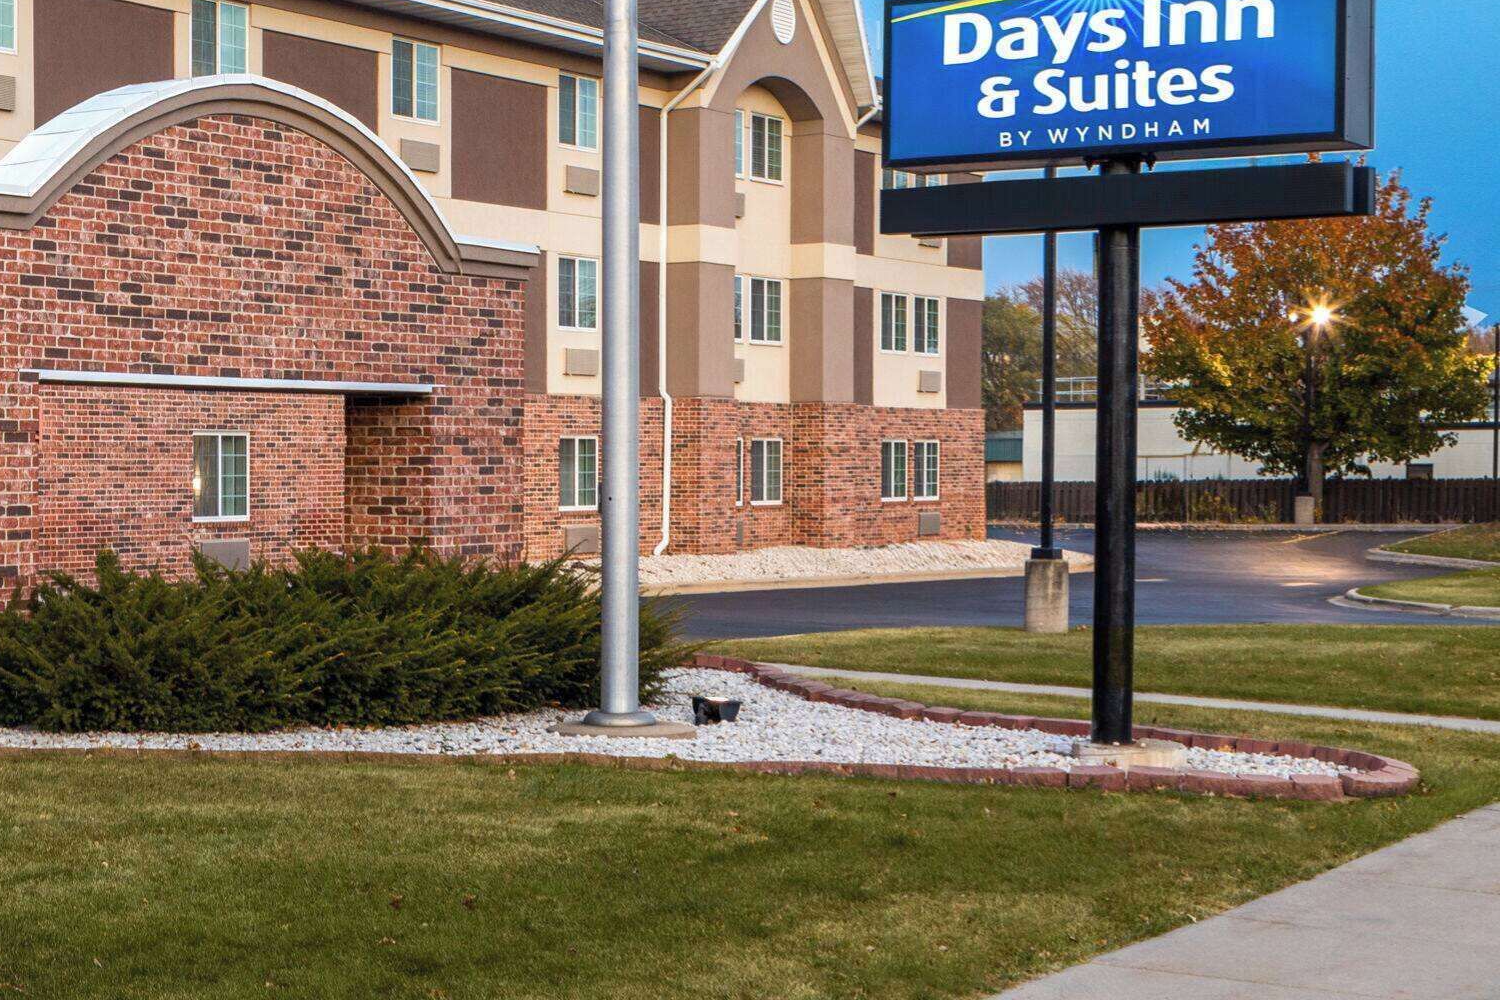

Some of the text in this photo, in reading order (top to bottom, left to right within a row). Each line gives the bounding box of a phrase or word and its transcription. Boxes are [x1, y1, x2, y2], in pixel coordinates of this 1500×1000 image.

[943, 9, 1125, 65] Days
[977, 60, 1235, 118] & Suites
[1000, 118, 1211, 148] BY WYNDHAM
